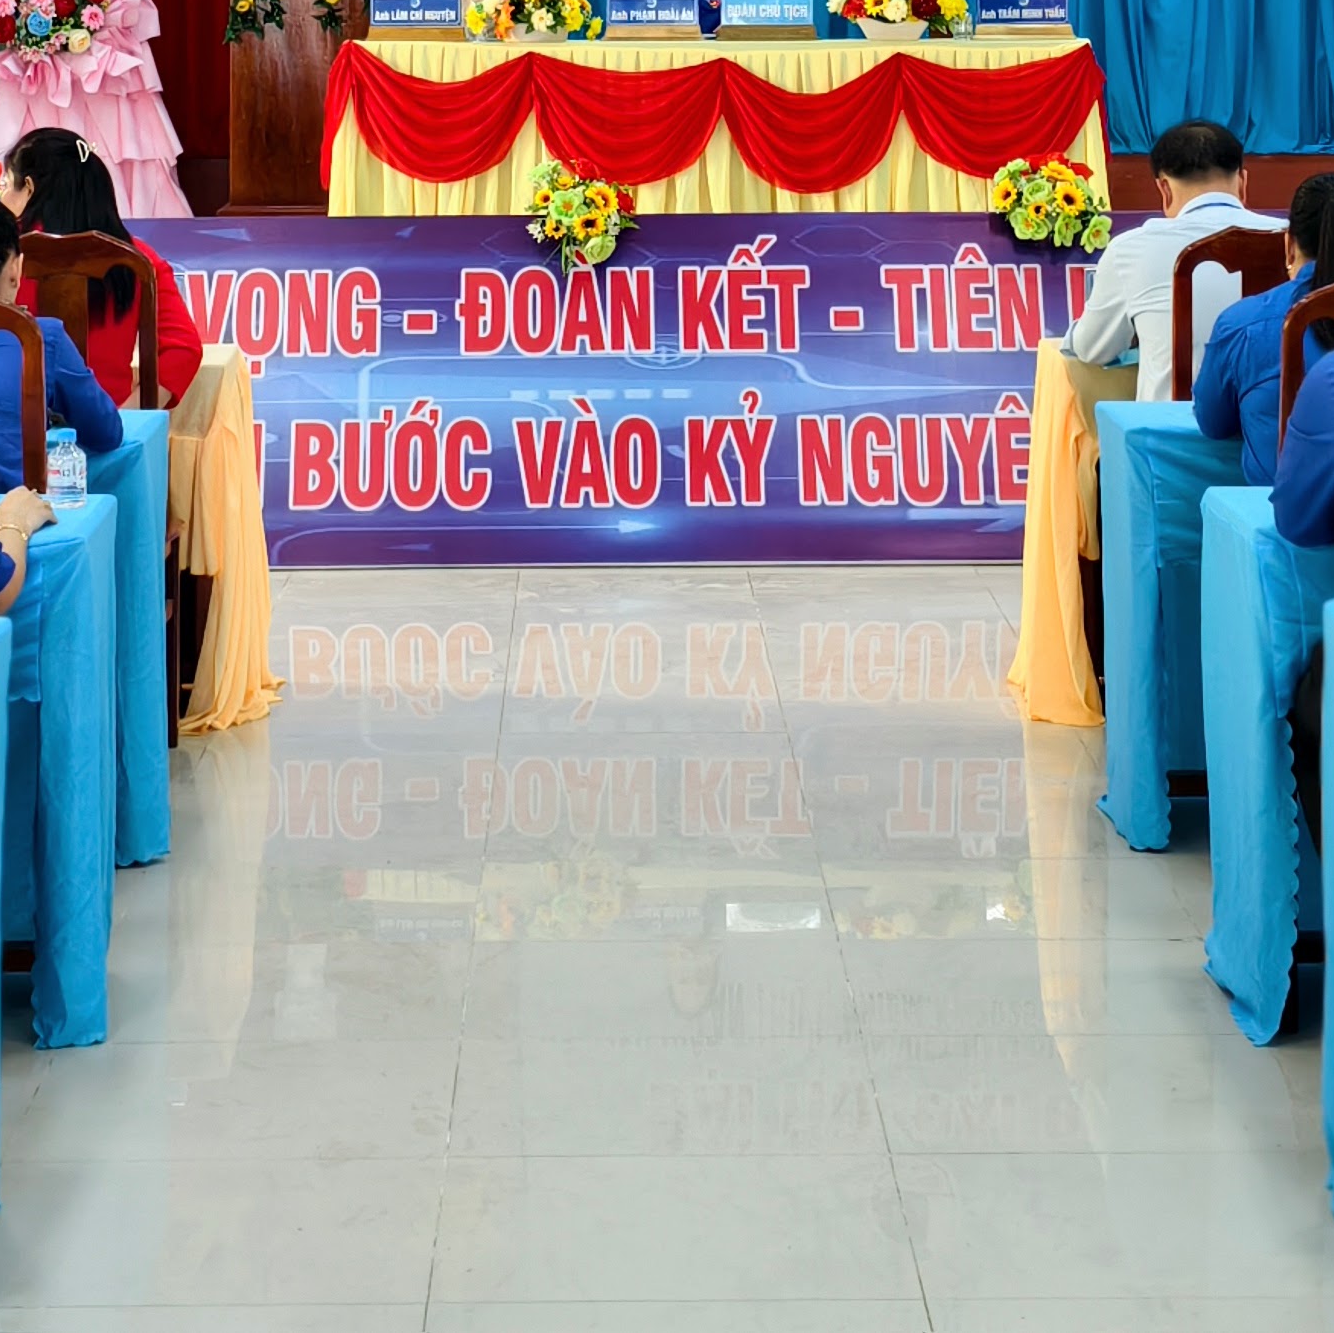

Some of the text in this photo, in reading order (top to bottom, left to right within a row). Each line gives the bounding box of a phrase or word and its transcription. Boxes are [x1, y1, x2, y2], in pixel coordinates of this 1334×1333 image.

[185, 268, 381, 378] VỌNG
[457, 248, 654, 355] ĐOÀN
[678, 234, 810, 354] KẾT
[881, 243, 1045, 352] TIÊN
[289, 396, 493, 512] BƯỚC
[513, 395, 661, 509] VÀO
[684, 387, 776, 507] KỶ
[796, 392, 1032, 506] NGUYÊ
